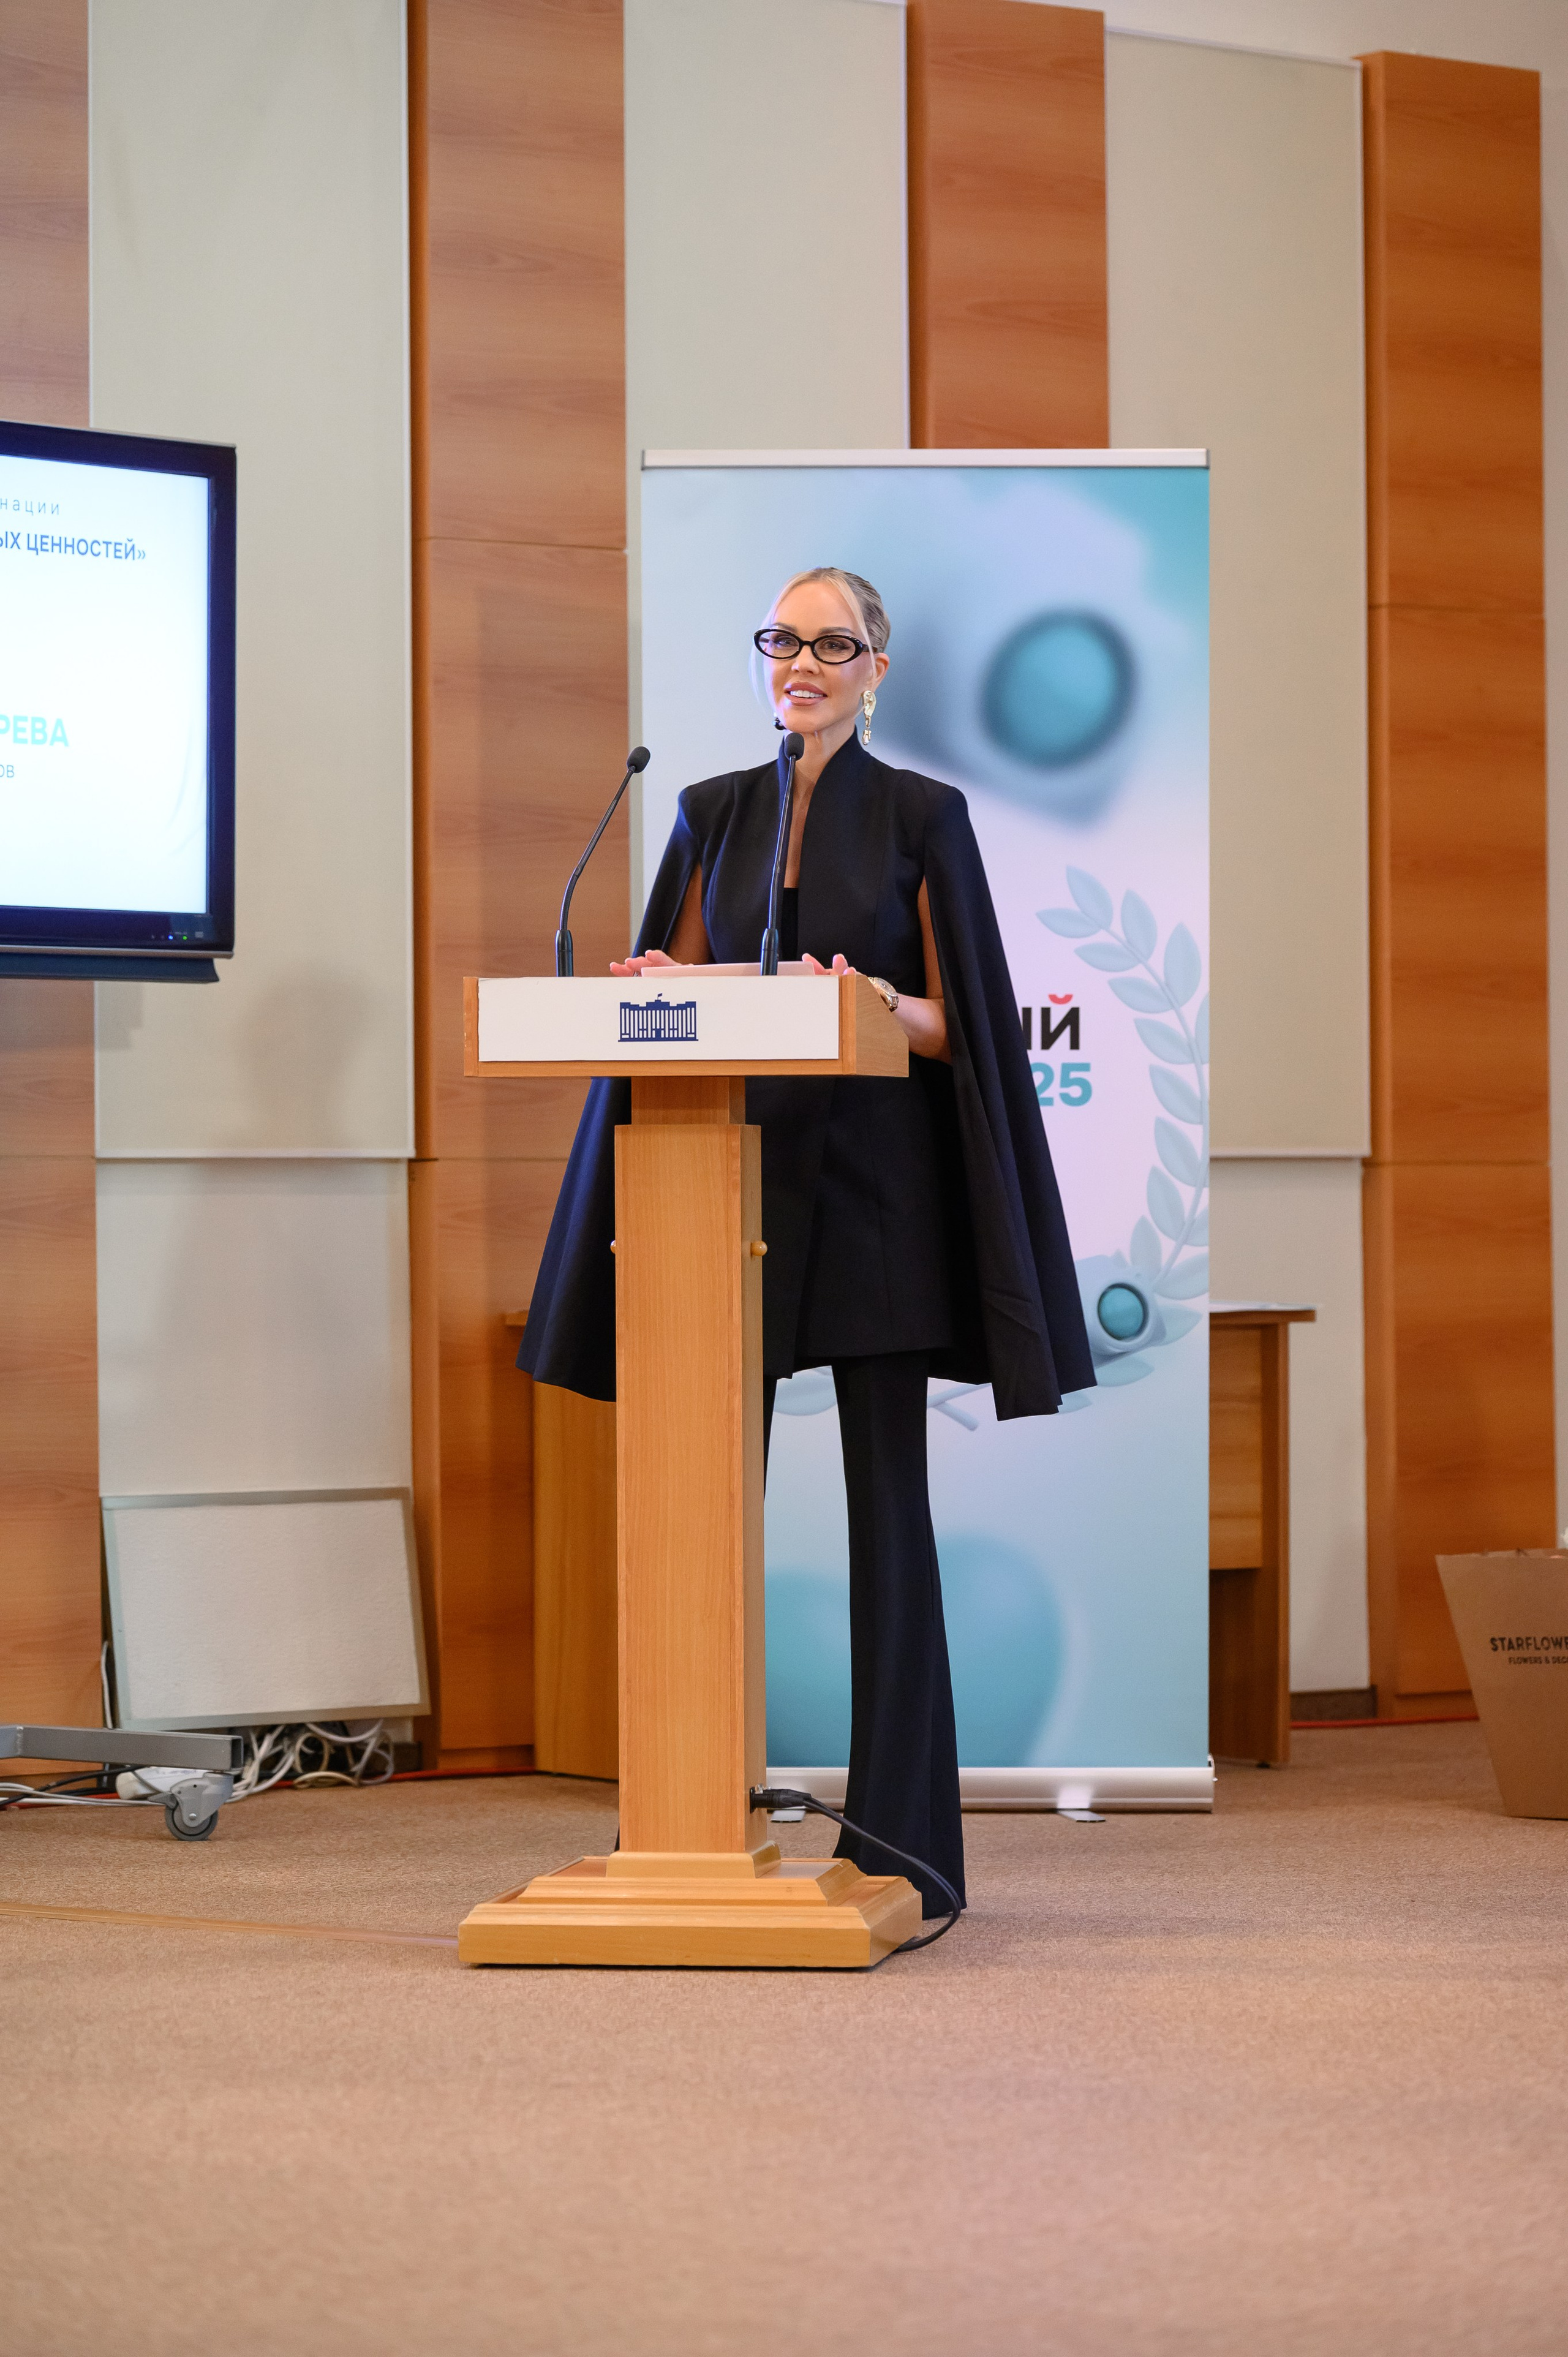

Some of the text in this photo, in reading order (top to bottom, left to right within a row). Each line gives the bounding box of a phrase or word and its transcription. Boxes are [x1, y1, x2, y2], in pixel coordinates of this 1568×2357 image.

[0, 498, 59, 516] нации
[27, 533, 146, 560] ЦЕННОСТЕЙ»
[0, 714, 69, 747] РЕВА
